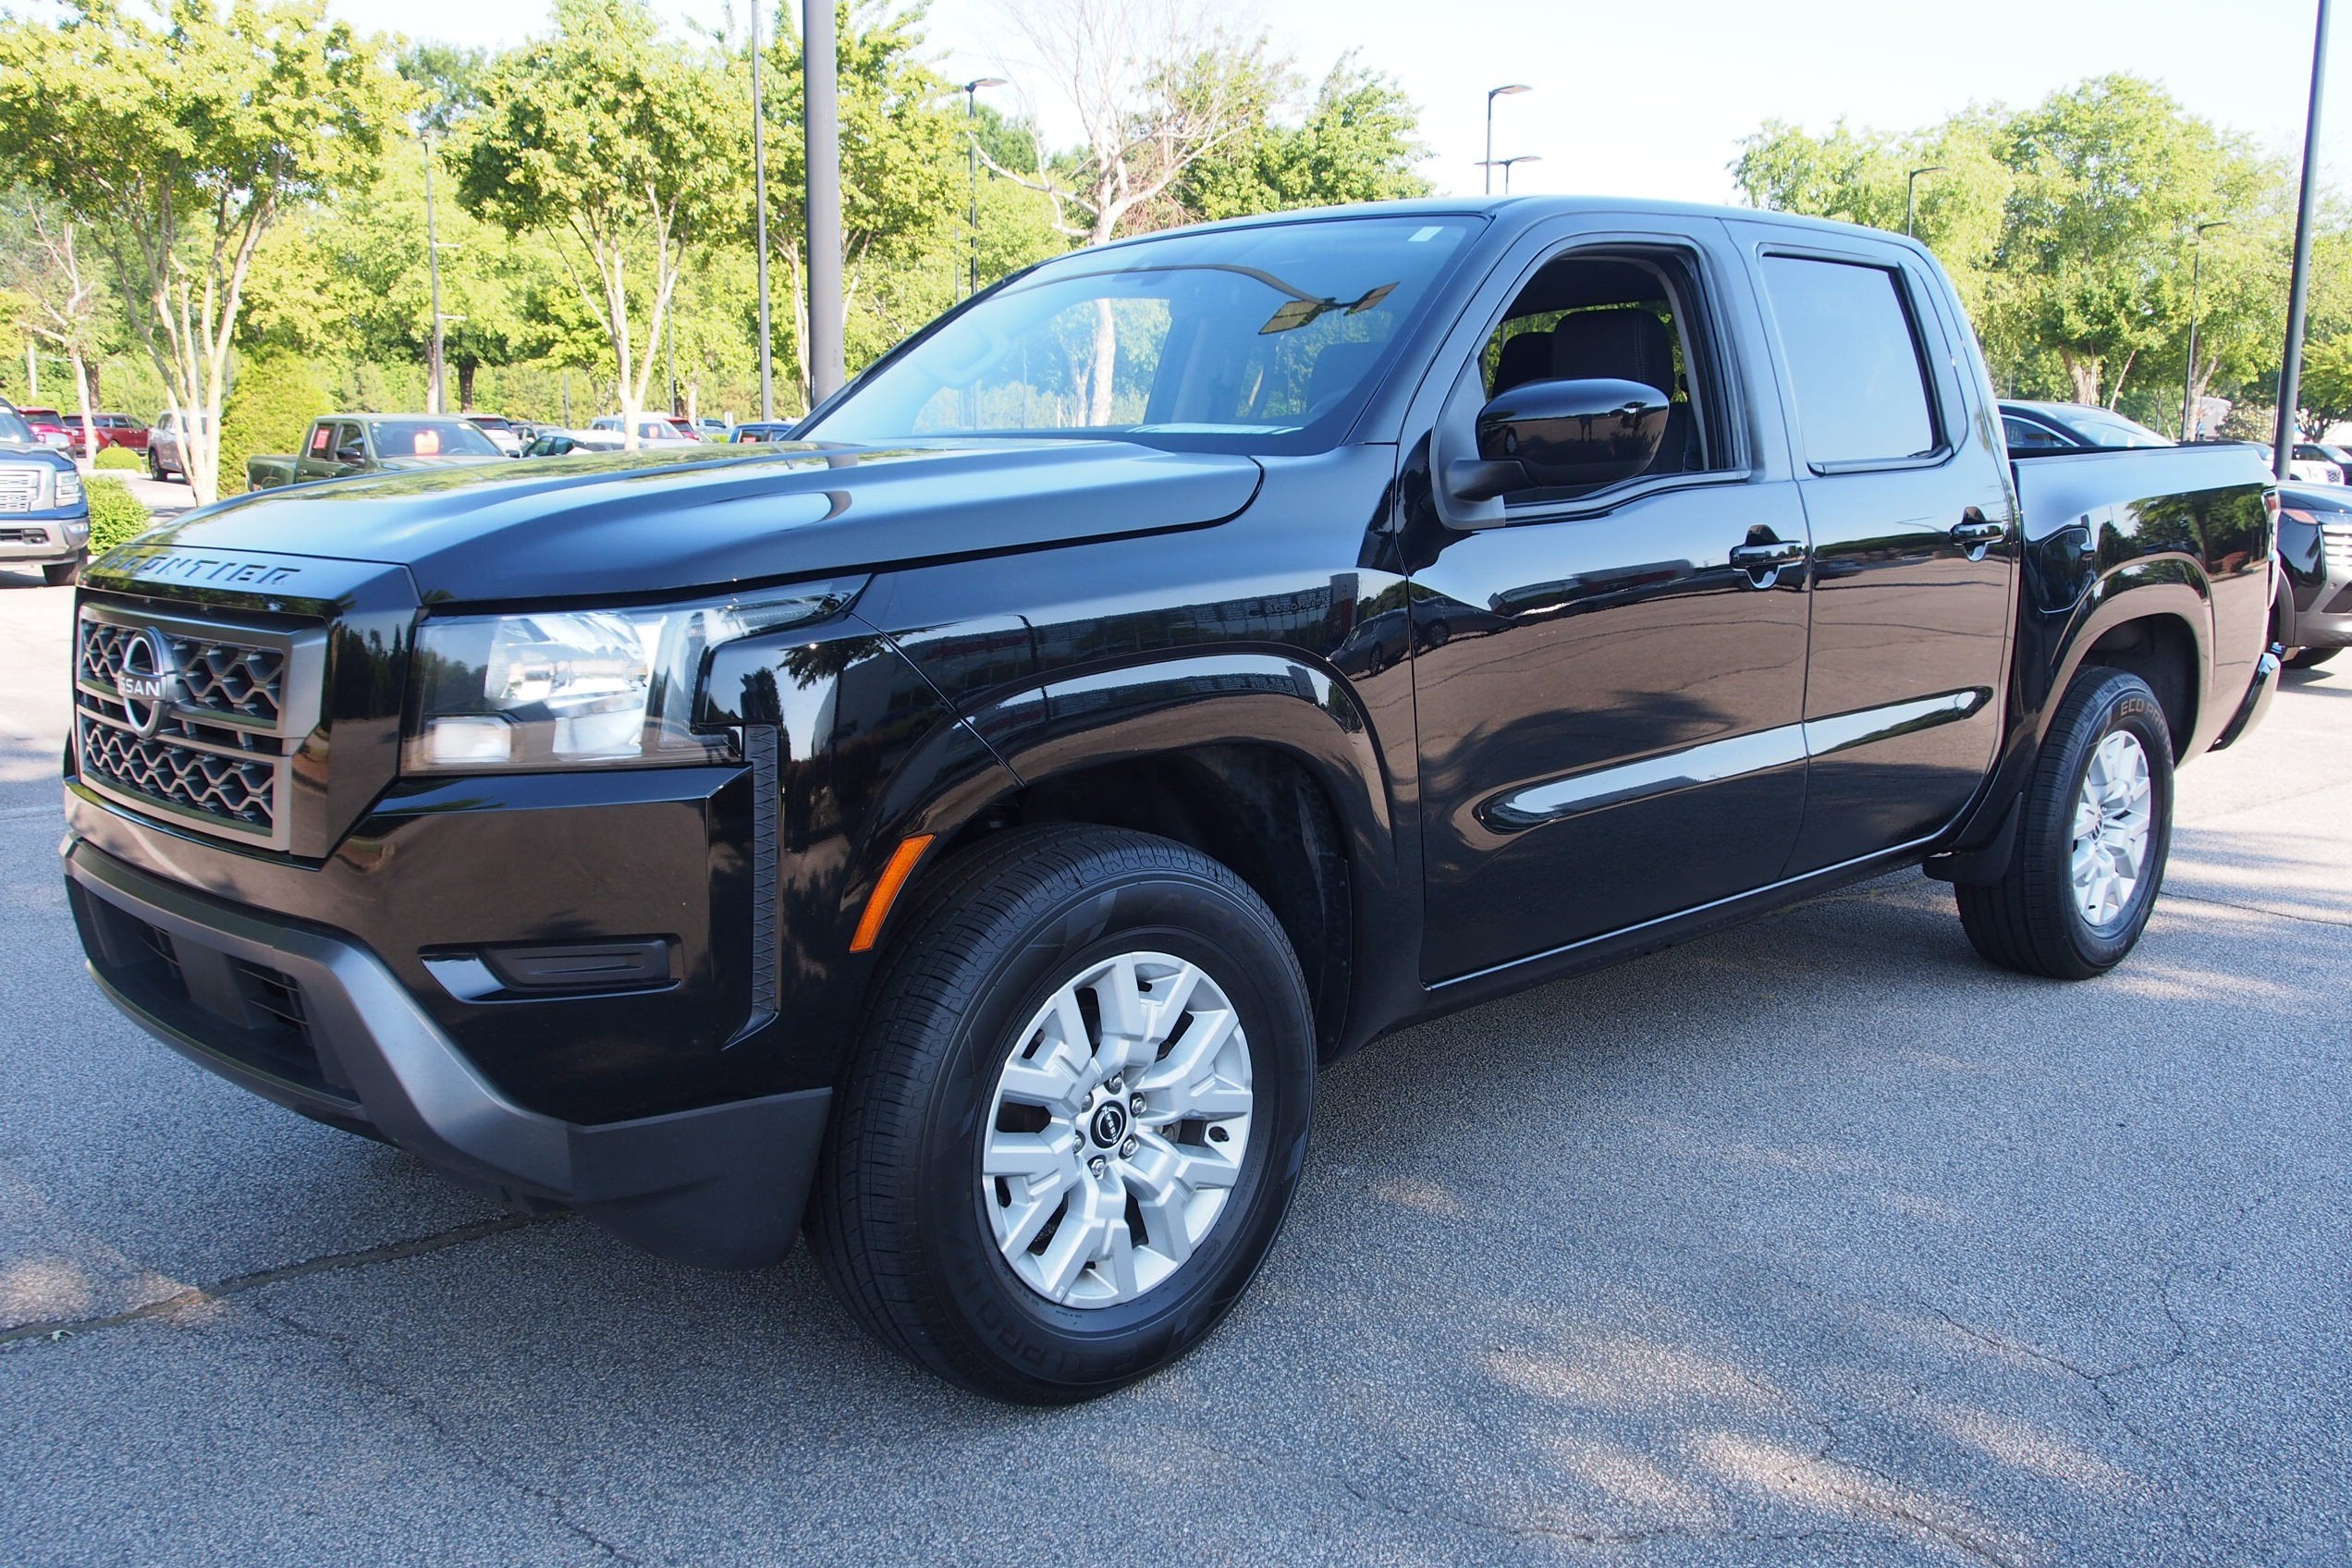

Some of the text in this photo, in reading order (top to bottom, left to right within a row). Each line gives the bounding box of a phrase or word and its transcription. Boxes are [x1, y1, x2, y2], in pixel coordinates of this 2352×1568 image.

[104, 556, 301, 586] FRONTIER
[2121, 698, 2145, 717] ECO
[1101, 1105, 1118, 1145] NISSAN
